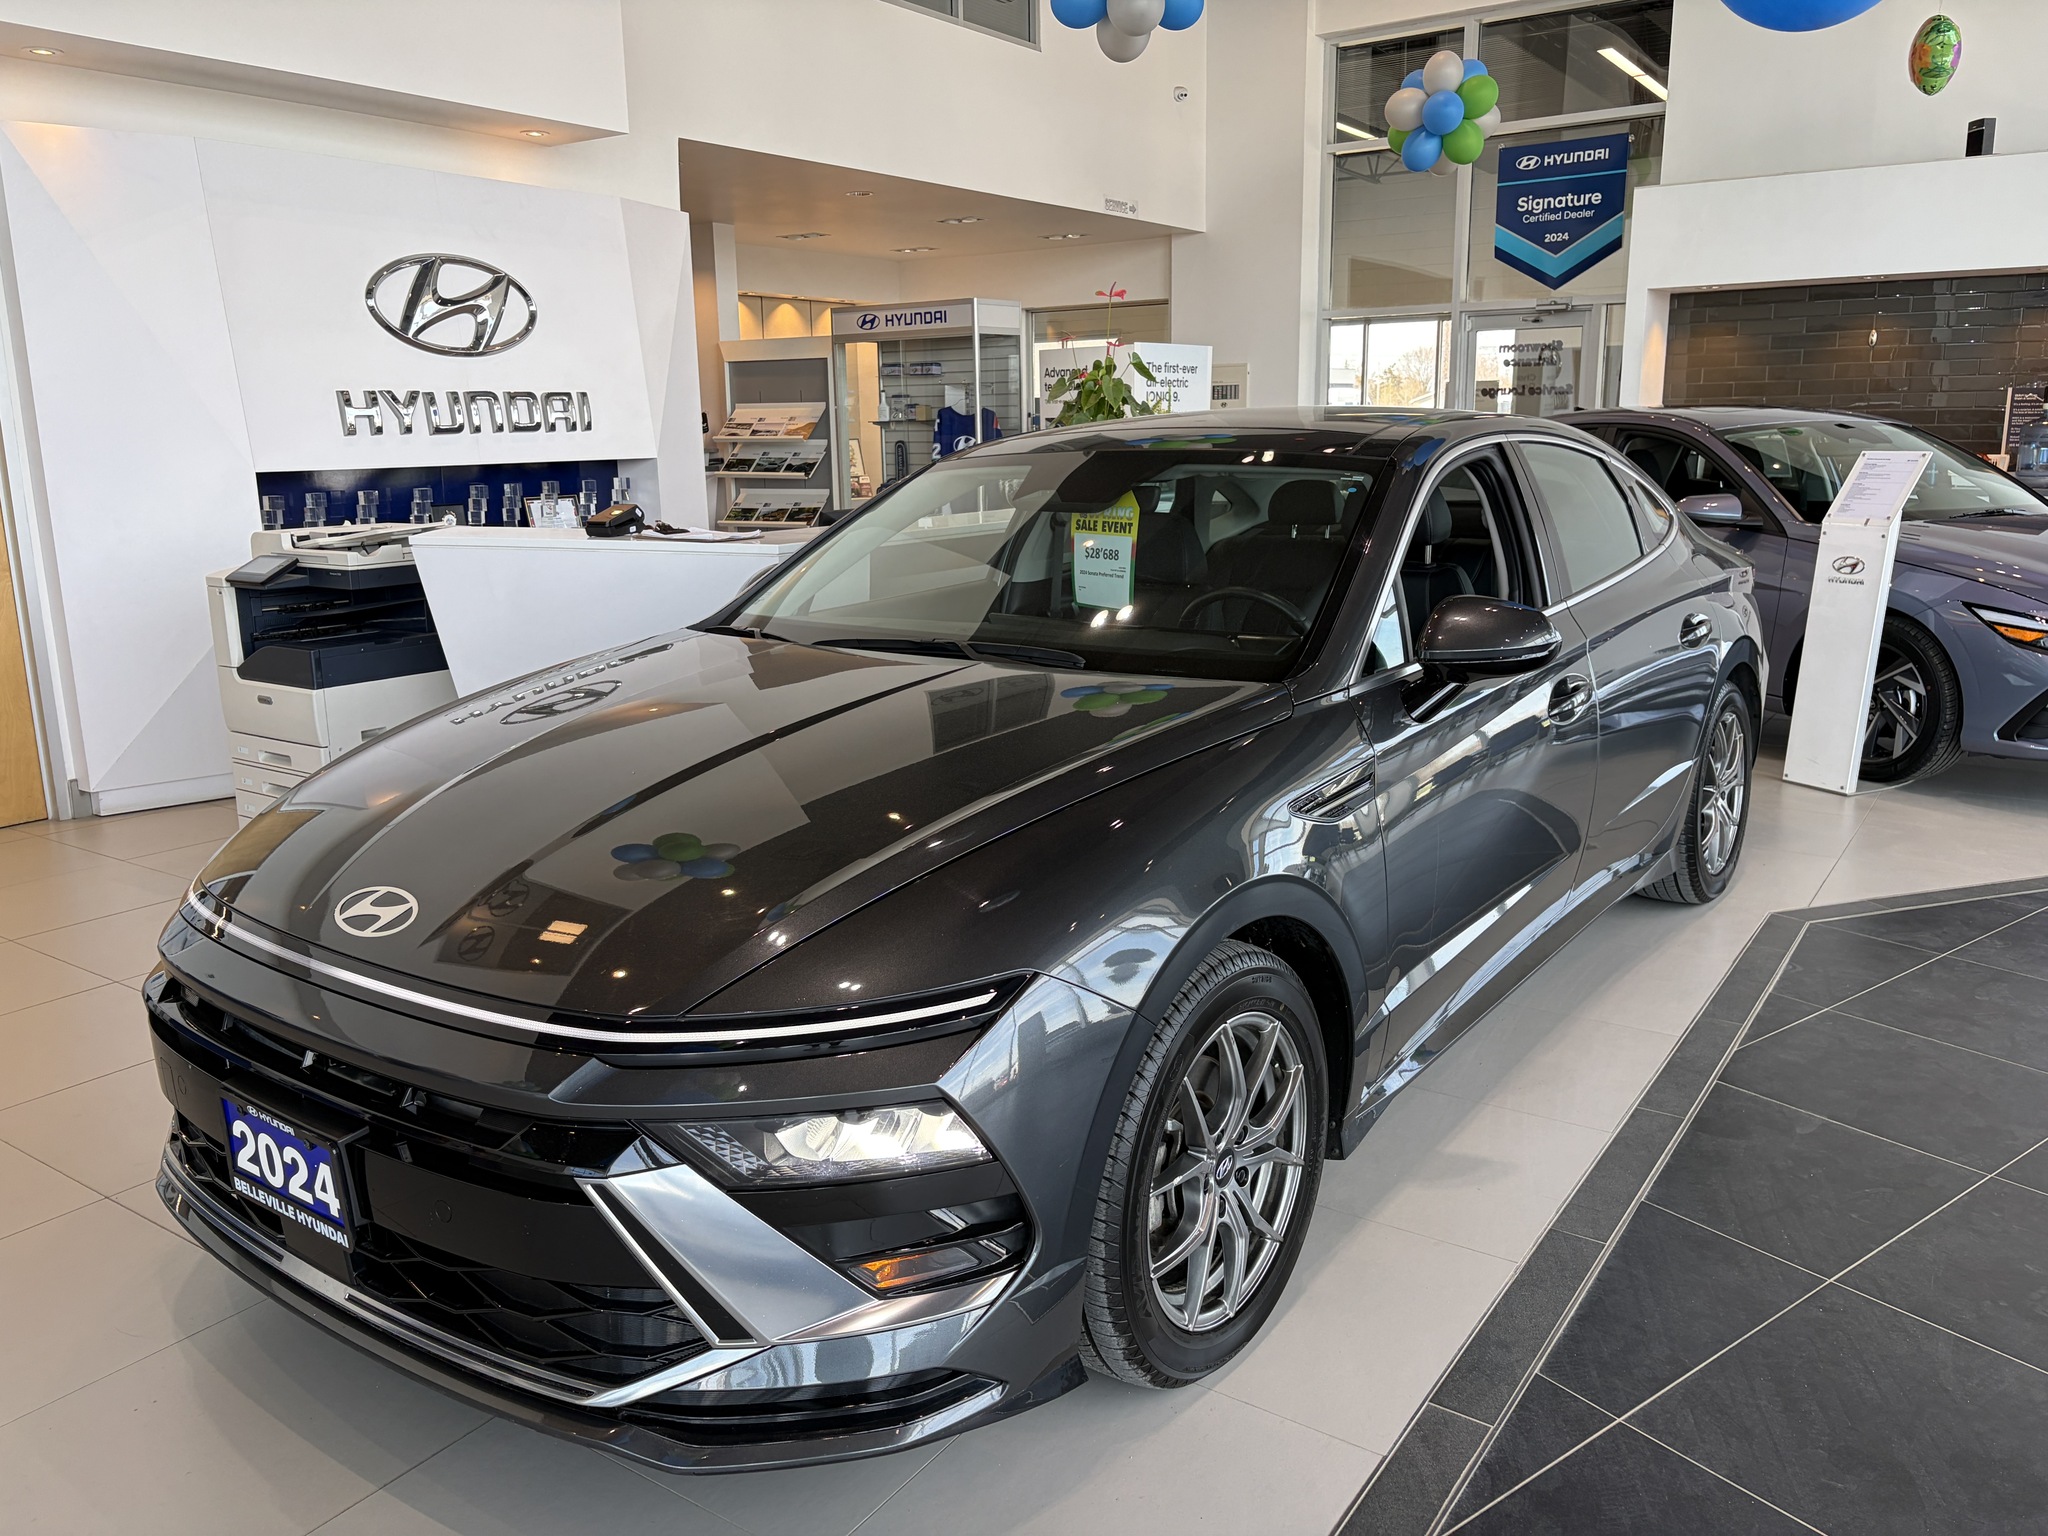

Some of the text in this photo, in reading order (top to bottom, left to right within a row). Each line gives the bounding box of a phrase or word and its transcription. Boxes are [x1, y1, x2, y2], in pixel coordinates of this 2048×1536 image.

[1544, 148, 1609, 166] HYUNDAI
[1517, 192, 1602, 213] Signature
[1522, 209, 1595, 223] Certified Dealer
[1544, 232, 1570, 242] 2024
[885, 310, 947, 327] HYUNDAI
[1146, 362, 1198, 374] The first-ever
[1173, 391, 1180, 402] 9.
[335, 390, 593, 436] HYUNDAI
[1075, 519, 1133, 534] SALE EVENT
[259, 1111, 295, 1136] HYUNDAI
[232, 1119, 341, 1218] 2024
[233, 1176, 349, 1248] BELLEVILLE HYUNDAI
